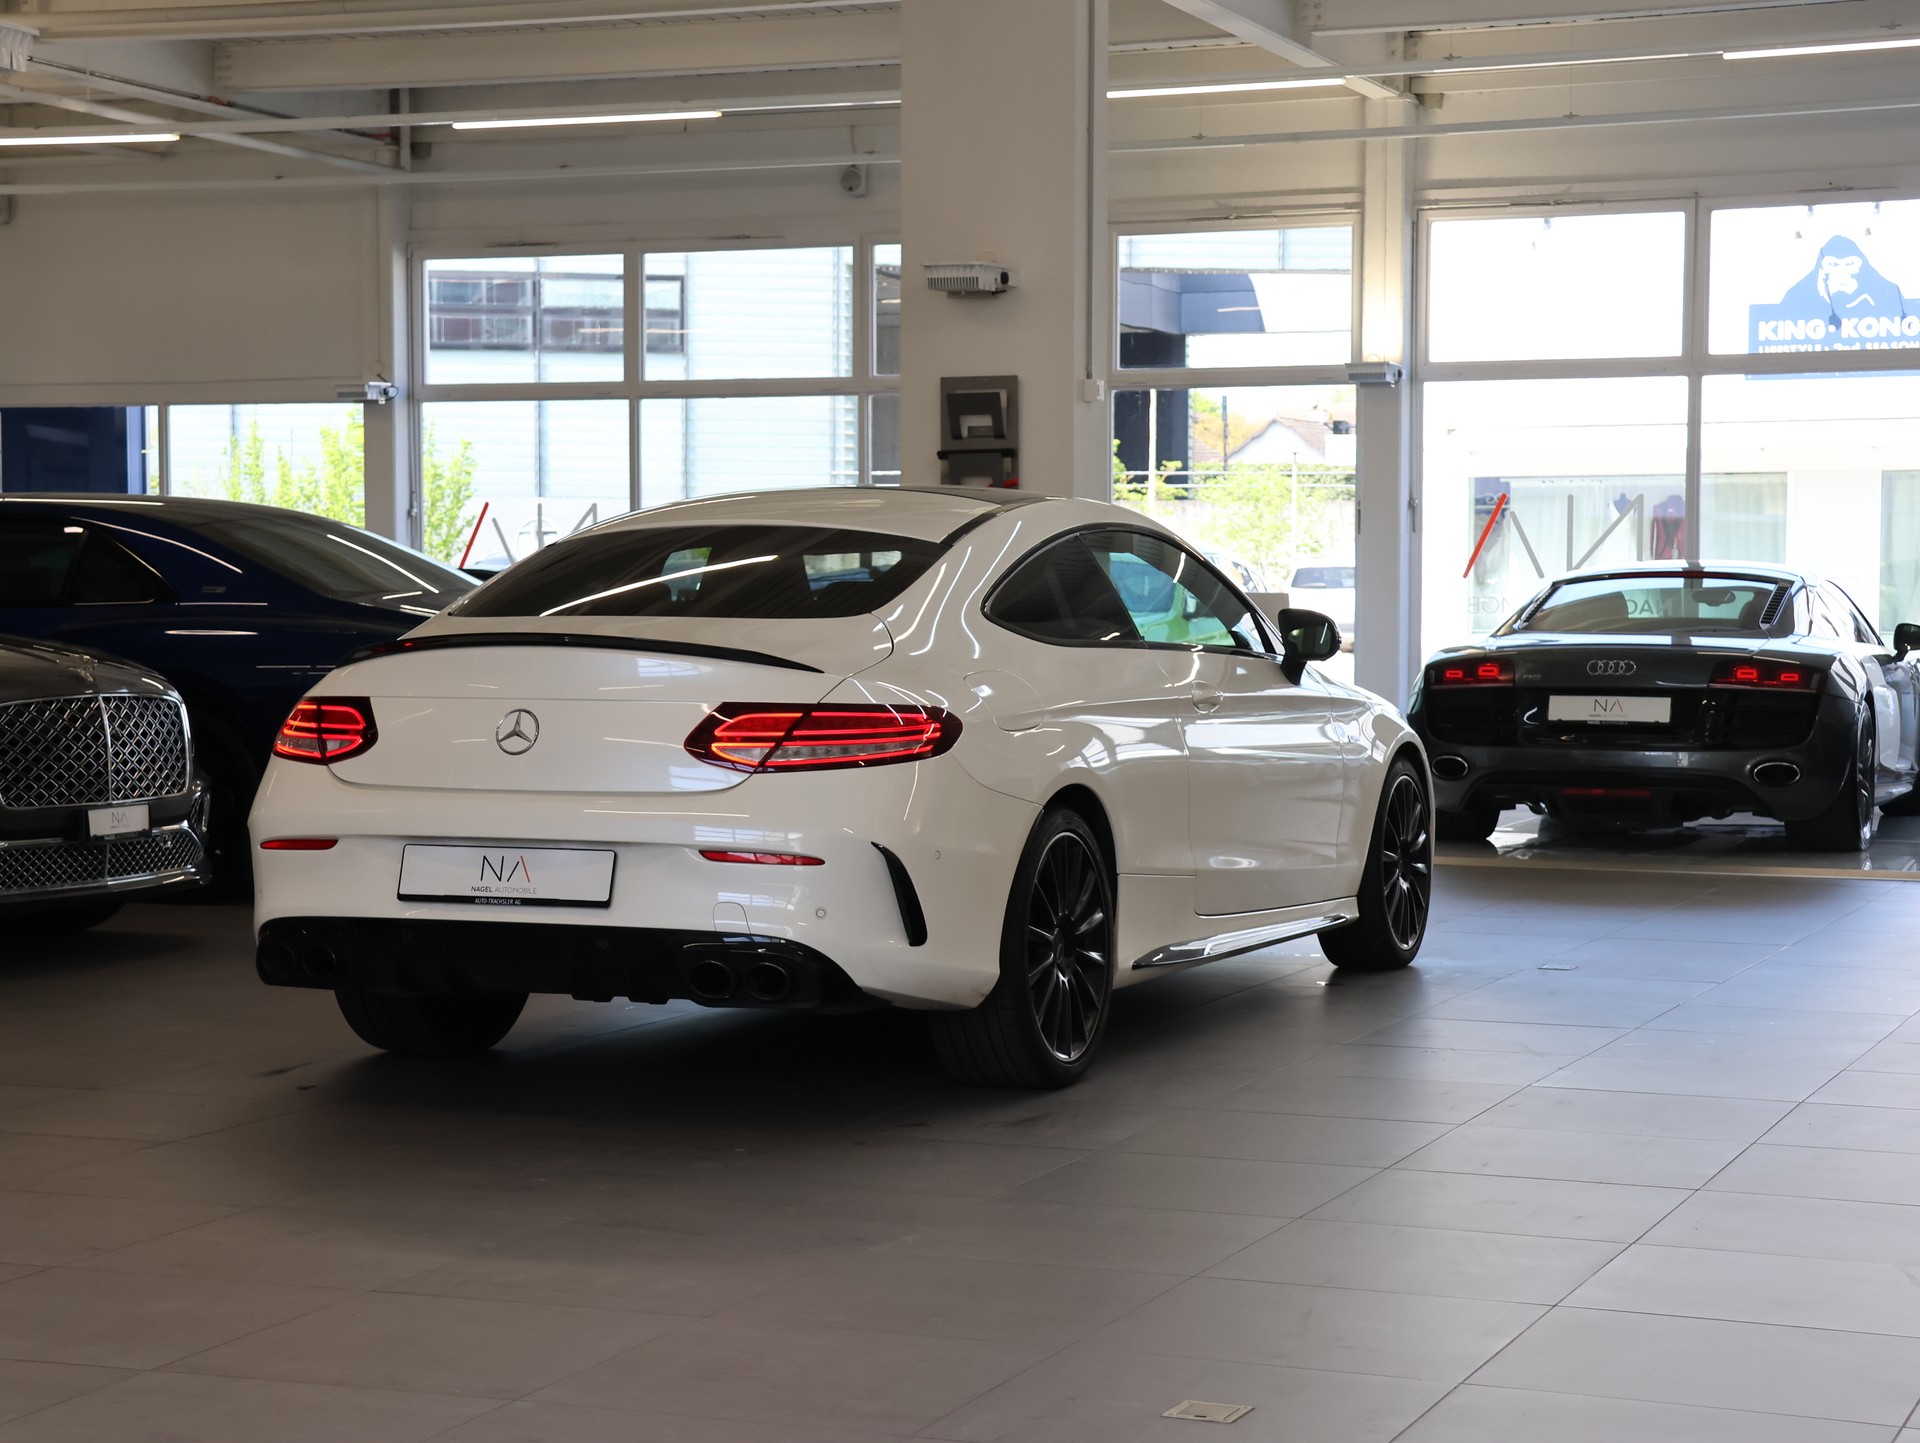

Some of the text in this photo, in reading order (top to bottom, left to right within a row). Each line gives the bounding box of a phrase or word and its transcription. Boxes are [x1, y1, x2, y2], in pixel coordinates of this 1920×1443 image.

[1758, 315, 1920, 341] KING KONG
[1593, 698, 1624, 713] NA
[480, 855, 531, 883] NA
[494, 886, 538, 895] AUTOMOBILE
